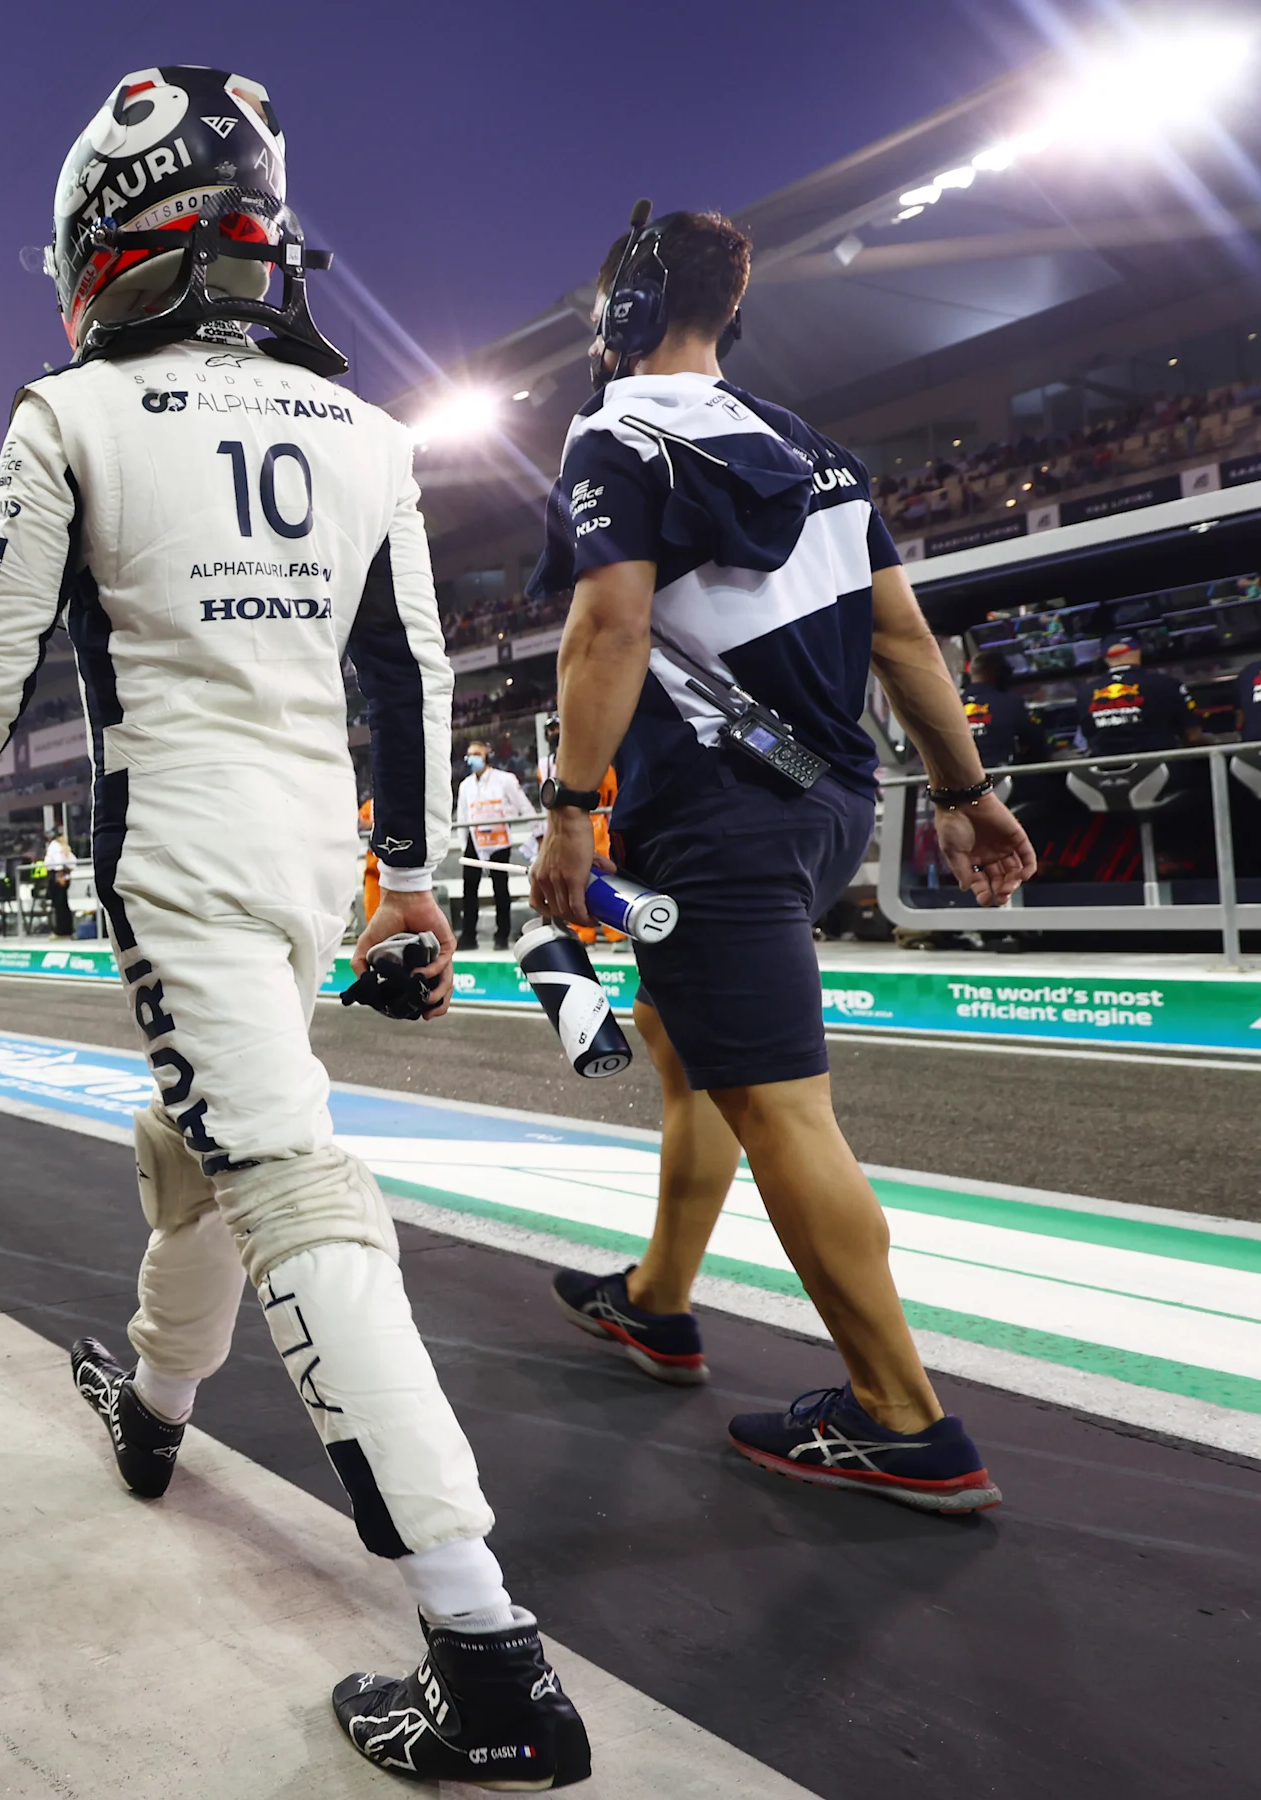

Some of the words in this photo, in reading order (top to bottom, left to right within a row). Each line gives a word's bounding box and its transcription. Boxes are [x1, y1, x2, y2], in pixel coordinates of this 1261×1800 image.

[134, 373, 340, 396] SCUDERIA
[197, 392, 354, 424] ALPHATAURI
[216, 440, 314, 539] 10
[190, 561, 332, 582] ALPHATAURI.FASN
[200, 597, 332, 622] HONDA
[642, 906, 671, 933] 10
[947, 982, 993, 1000] The
[996, 985, 1089, 1005] world's
[1093, 989, 1164, 1007] most
[956, 1000, 1058, 1021] efficient
[1061, 1006, 1153, 1026] engine
[593, 1057, 621, 1074] 10
[490, 1746, 519, 1761] GASLY
